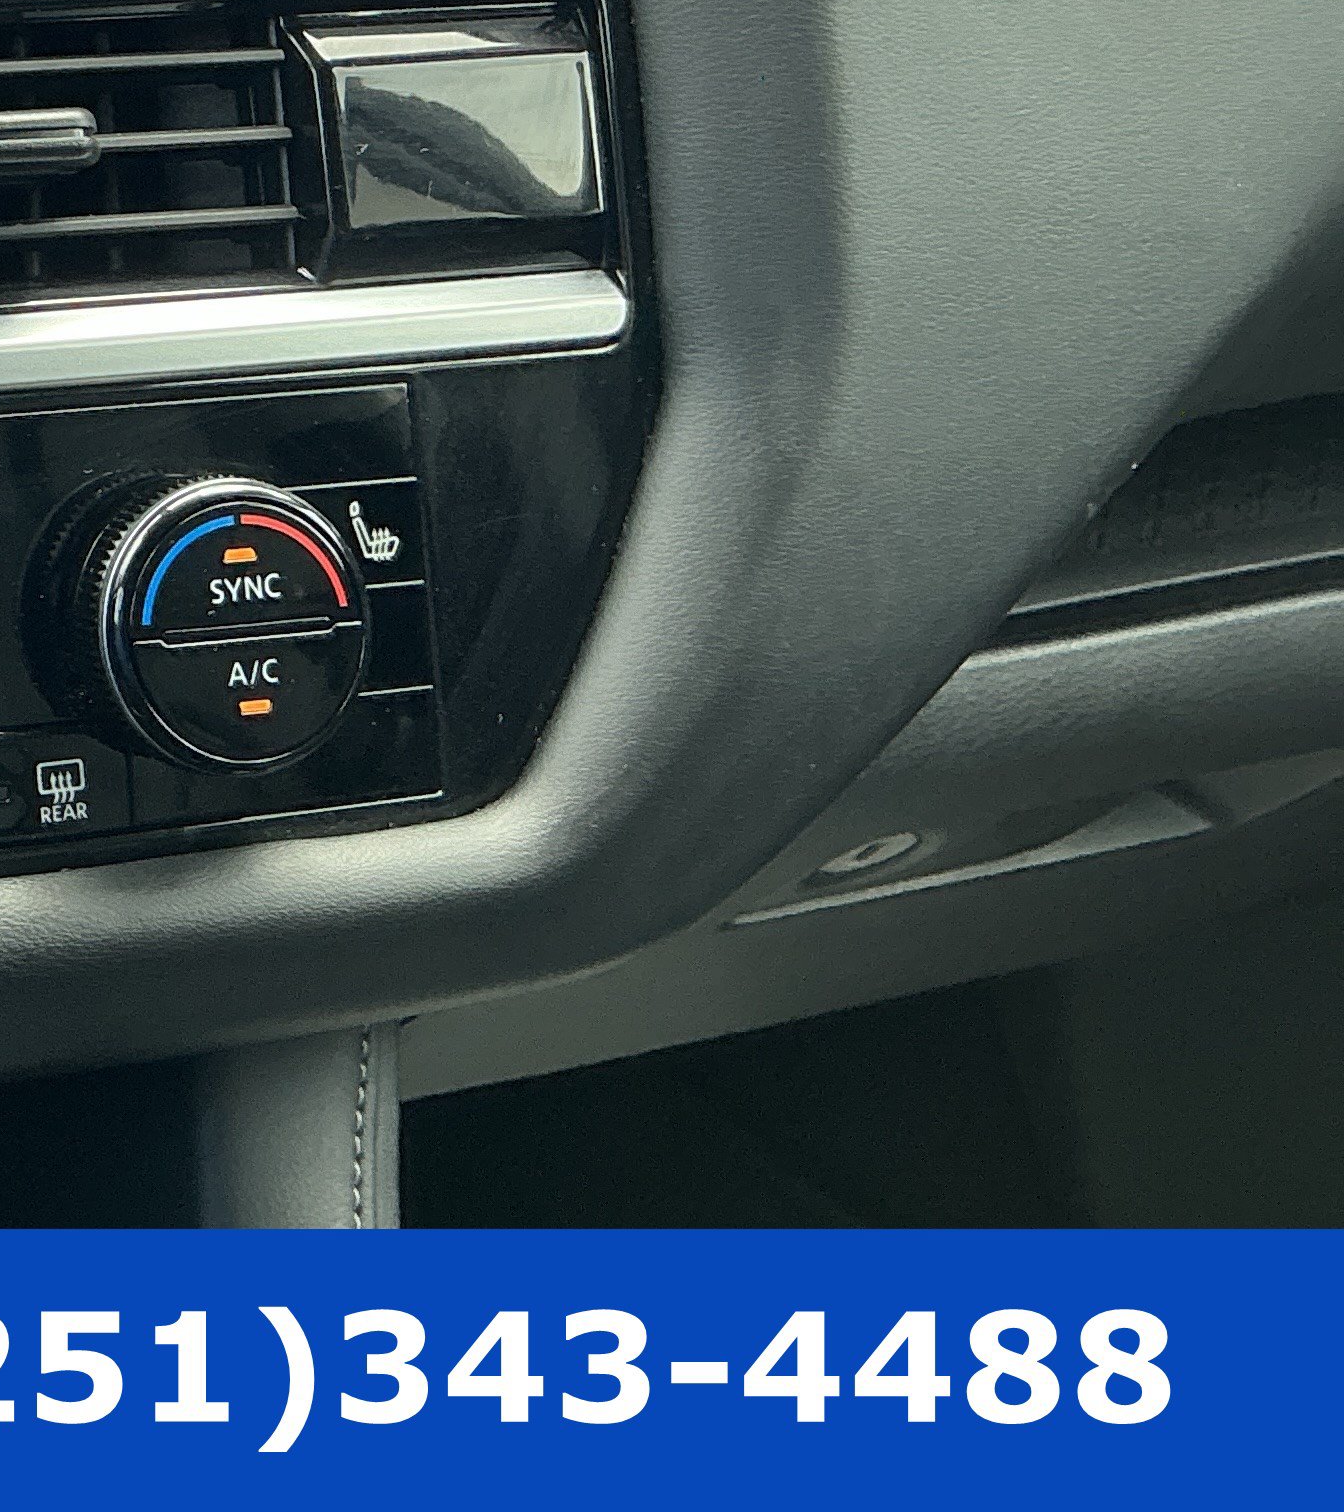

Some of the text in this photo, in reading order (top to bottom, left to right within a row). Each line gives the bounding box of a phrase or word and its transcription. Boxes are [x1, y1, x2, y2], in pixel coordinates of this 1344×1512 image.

[208, 572, 282, 606] SYNC
[227, 657, 280, 688] A/C
[38, 802, 89, 825] REAR
